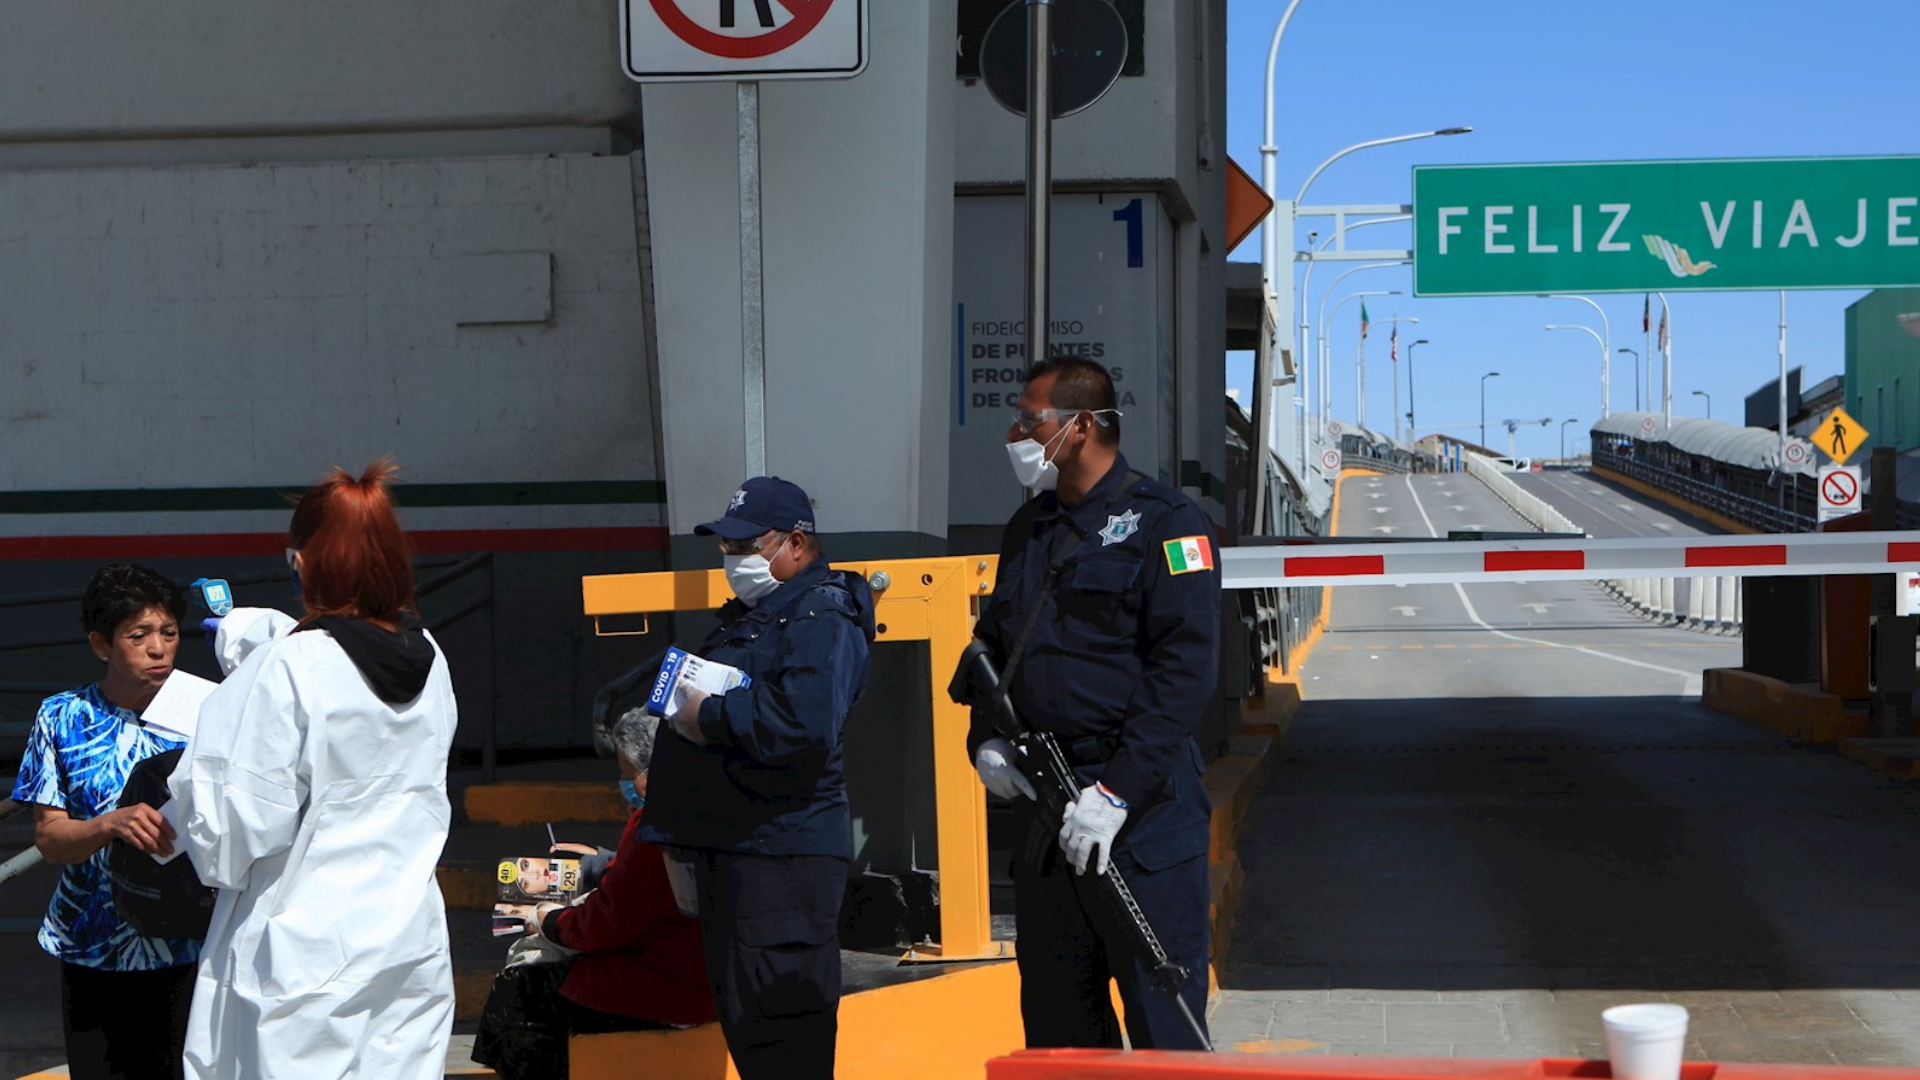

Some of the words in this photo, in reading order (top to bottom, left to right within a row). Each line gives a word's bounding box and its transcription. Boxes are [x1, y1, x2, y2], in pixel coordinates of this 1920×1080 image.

[1113, 198, 1143, 268] 1
[1438, 203, 1632, 255] FELIZ
[1700, 197, 1919, 249] VIAJE
[972, 321, 1083, 336] FIDEICISO
[971, 343, 1000, 359] DE
[1005, 342, 1105, 358] PNTES
[971, 393, 1000, 409] DE
[1791, 448, 1800, 456] 15
[651, 671, 670, 703] COVID
[668, 652, 677, 663] 19
